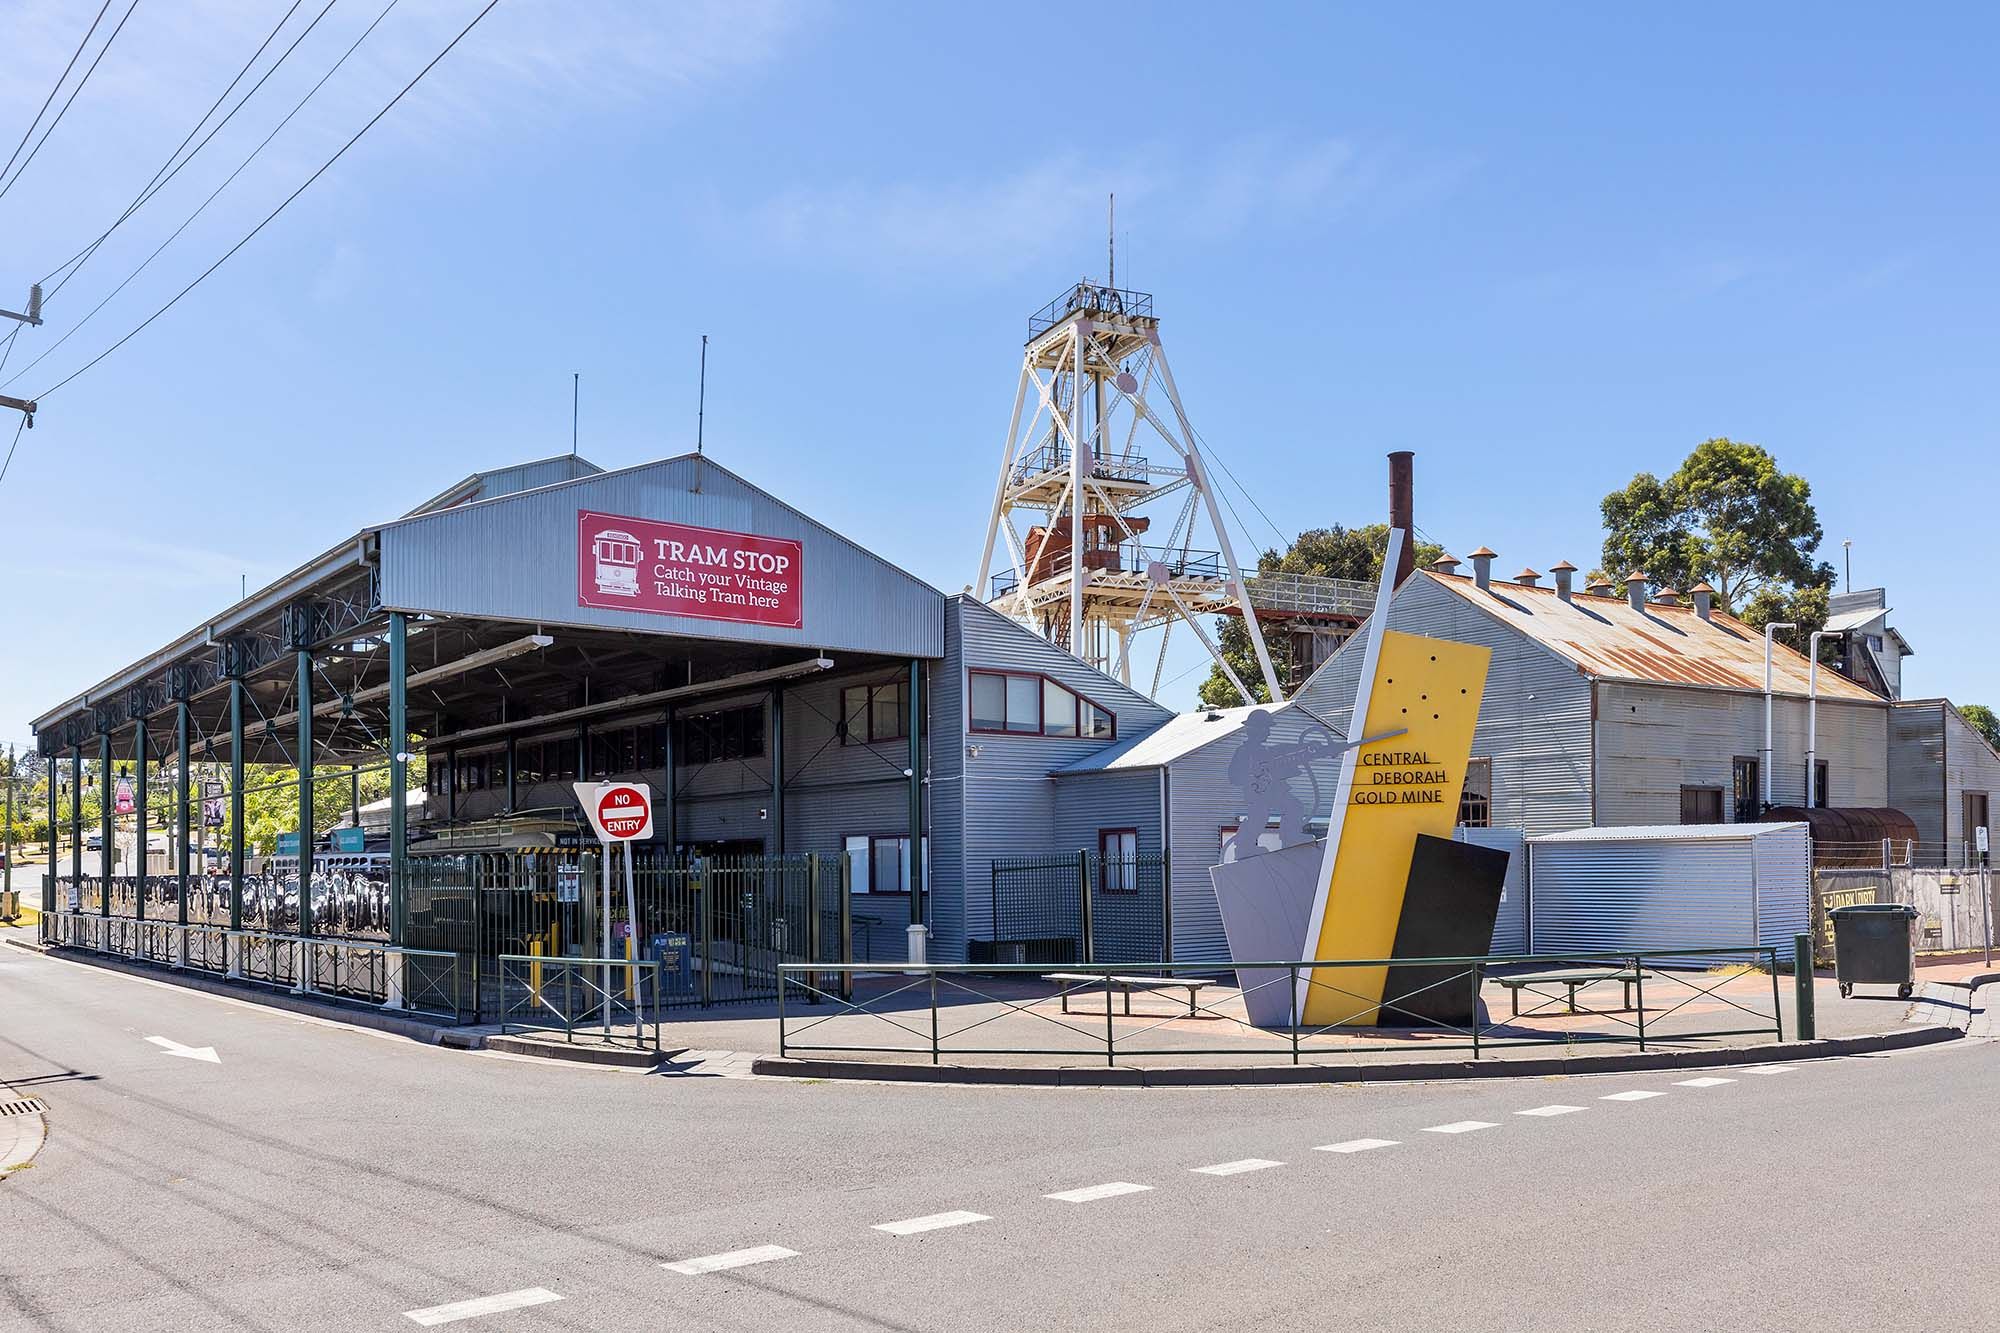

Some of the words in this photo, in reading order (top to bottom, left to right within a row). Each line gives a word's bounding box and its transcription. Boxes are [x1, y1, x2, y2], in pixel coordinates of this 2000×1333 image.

[654, 539, 727, 567] TRAM
[733, 550, 789, 574] STOP
[654, 564, 695, 582] Catch
[699, 572, 732, 586] your
[735, 573, 788, 594] Vintage
[654, 581, 706, 603] Talking
[709, 587, 748, 605] Tram
[749, 592, 779, 608] here
[1363, 752, 1430, 766] CENTRAL
[1373, 770, 1446, 784] DEBORAH
[614, 794, 630, 805] NO
[1355, 791, 1397, 804] GOLD
[1402, 790, 1442, 803] MINE
[607, 820, 640, 832] ENTRY
[560, 837, 570, 845] NOT
